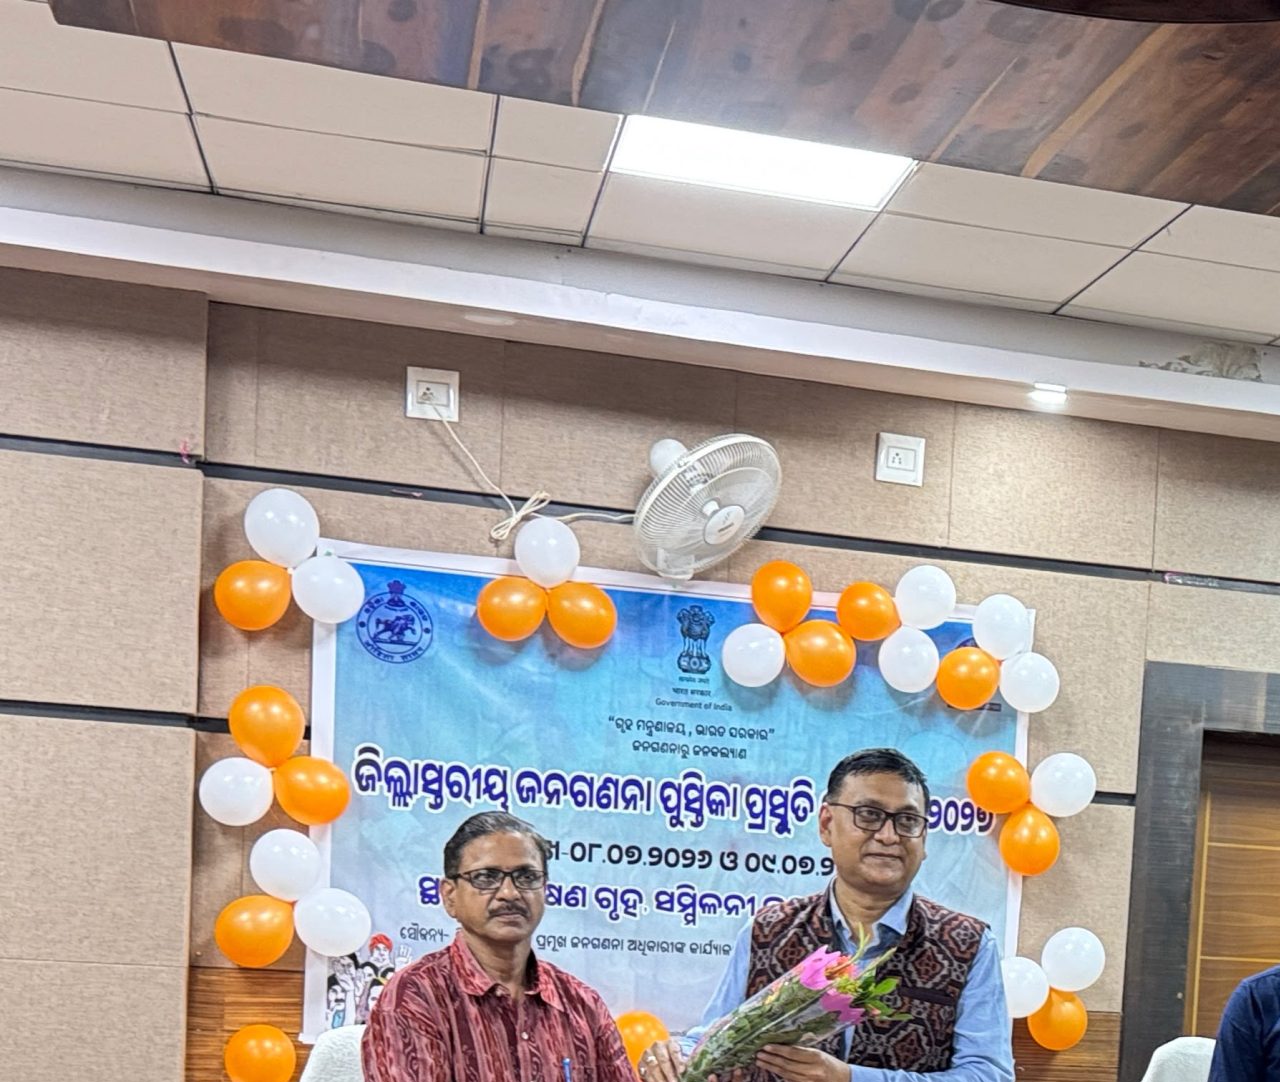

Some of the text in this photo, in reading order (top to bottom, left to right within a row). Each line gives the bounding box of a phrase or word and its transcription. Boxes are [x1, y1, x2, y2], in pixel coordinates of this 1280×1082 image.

[656, 698, 733, 712] Government of India
[515, 770, 652, 812] ଜନଗଣନା
[659, 771, 738, 828] ପୁସ୍ତିକା
[719, 851, 739, 871] ଓ
[745, 852, 835, 877] ୦୯.୦୭.୨
[570, 936, 624, 951] ଜନଗଣନା
